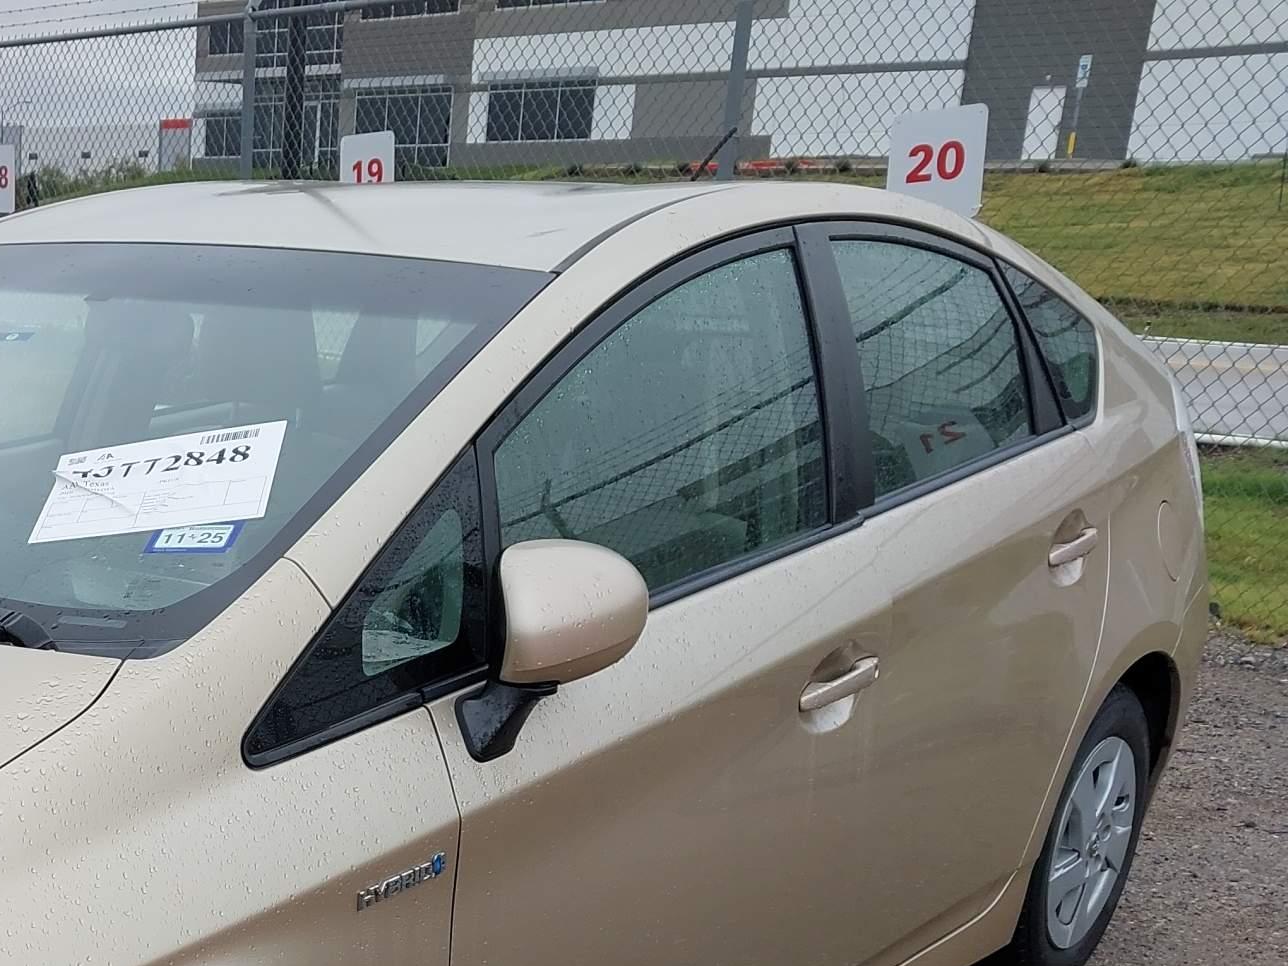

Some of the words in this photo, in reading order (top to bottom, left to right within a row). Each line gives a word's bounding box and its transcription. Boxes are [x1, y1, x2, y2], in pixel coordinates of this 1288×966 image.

[352, 158, 383, 184] 19
[905, 140, 965, 184] 20
[196, 532, 226, 544] 25
